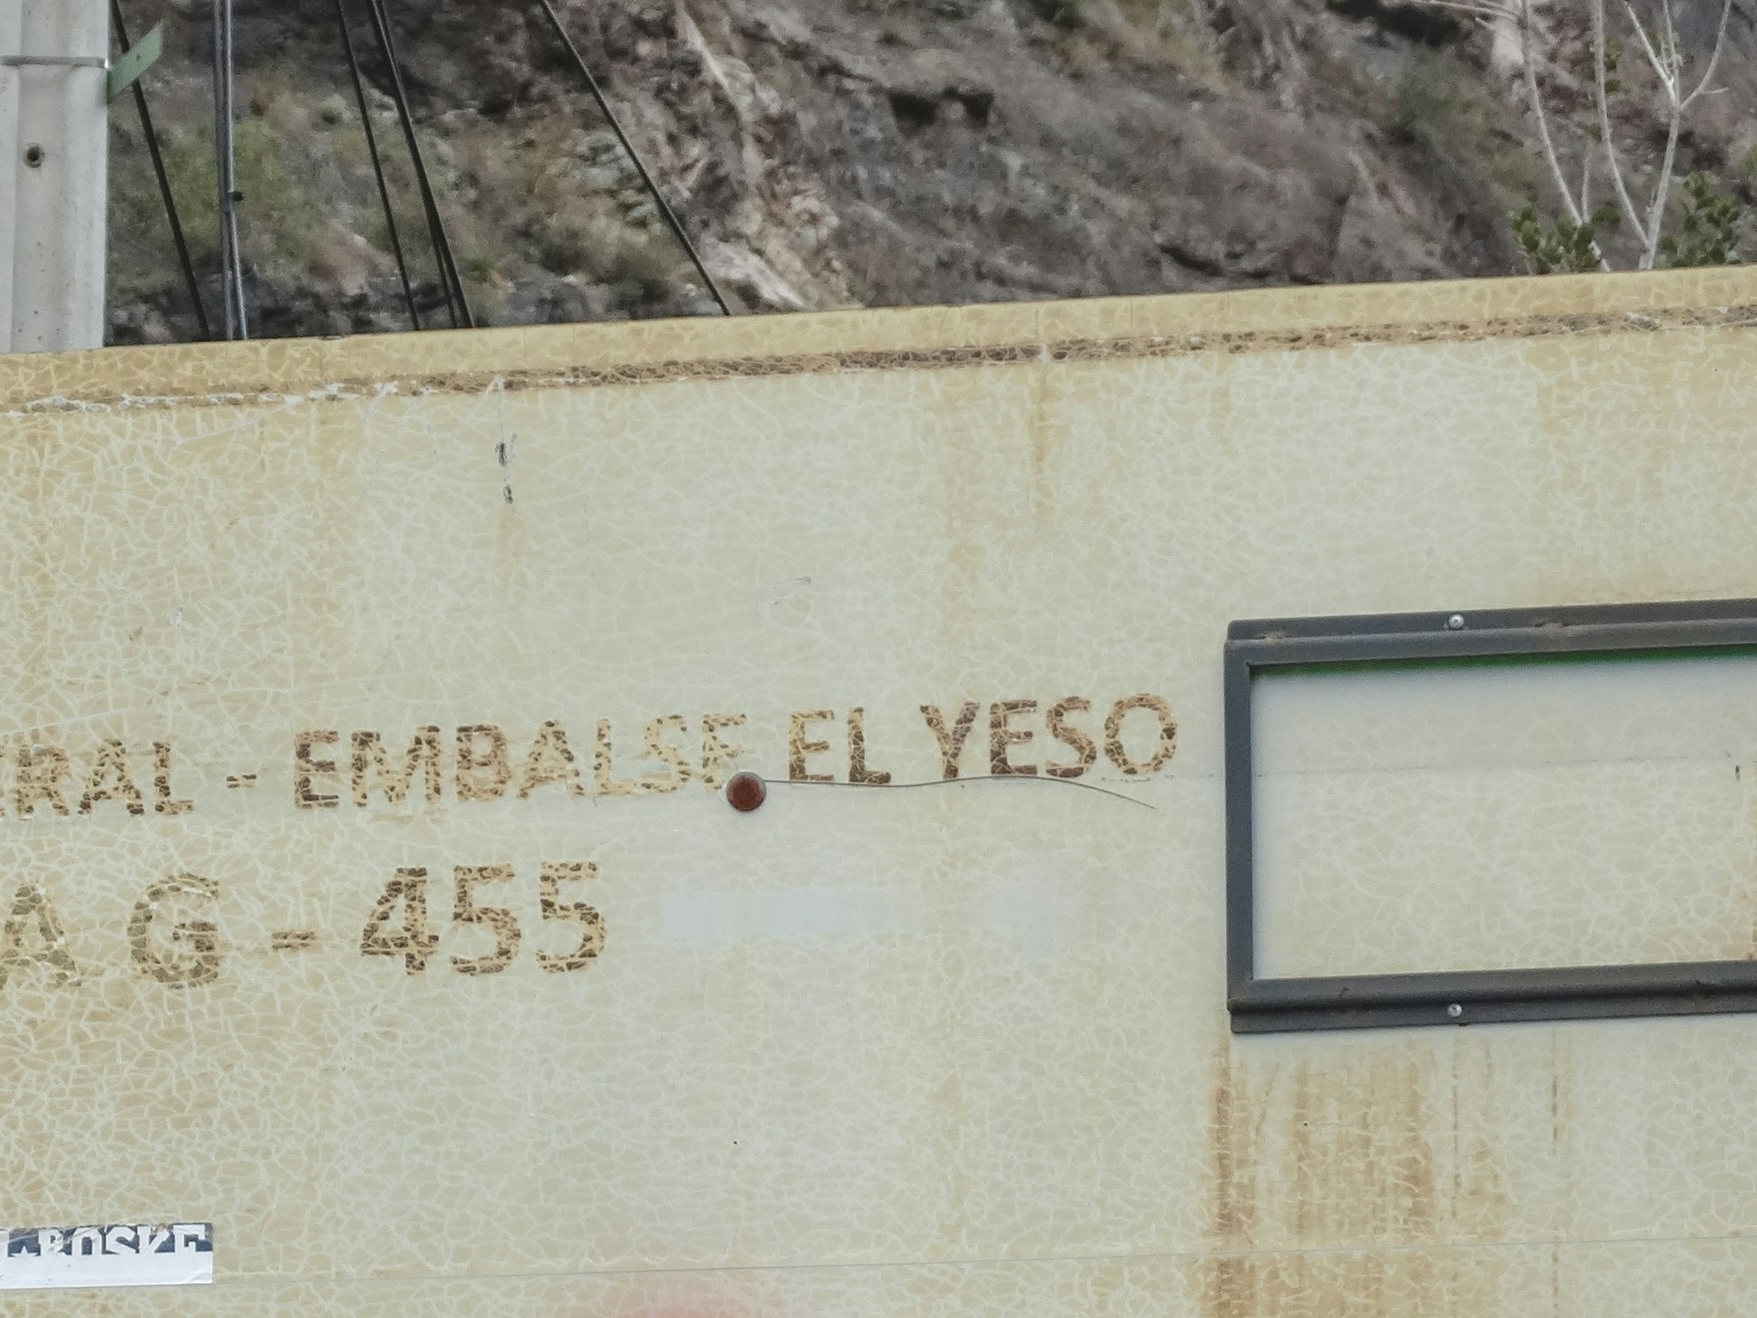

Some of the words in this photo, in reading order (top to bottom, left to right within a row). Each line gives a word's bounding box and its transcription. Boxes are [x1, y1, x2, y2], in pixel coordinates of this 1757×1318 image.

[293, 714, 747, 810] EMBALSE
[788, 705, 892, 786] EL
[920, 692, 1179, 782] YESO
[126, 873, 220, 989] G
[359, 861, 609, 976] 455
